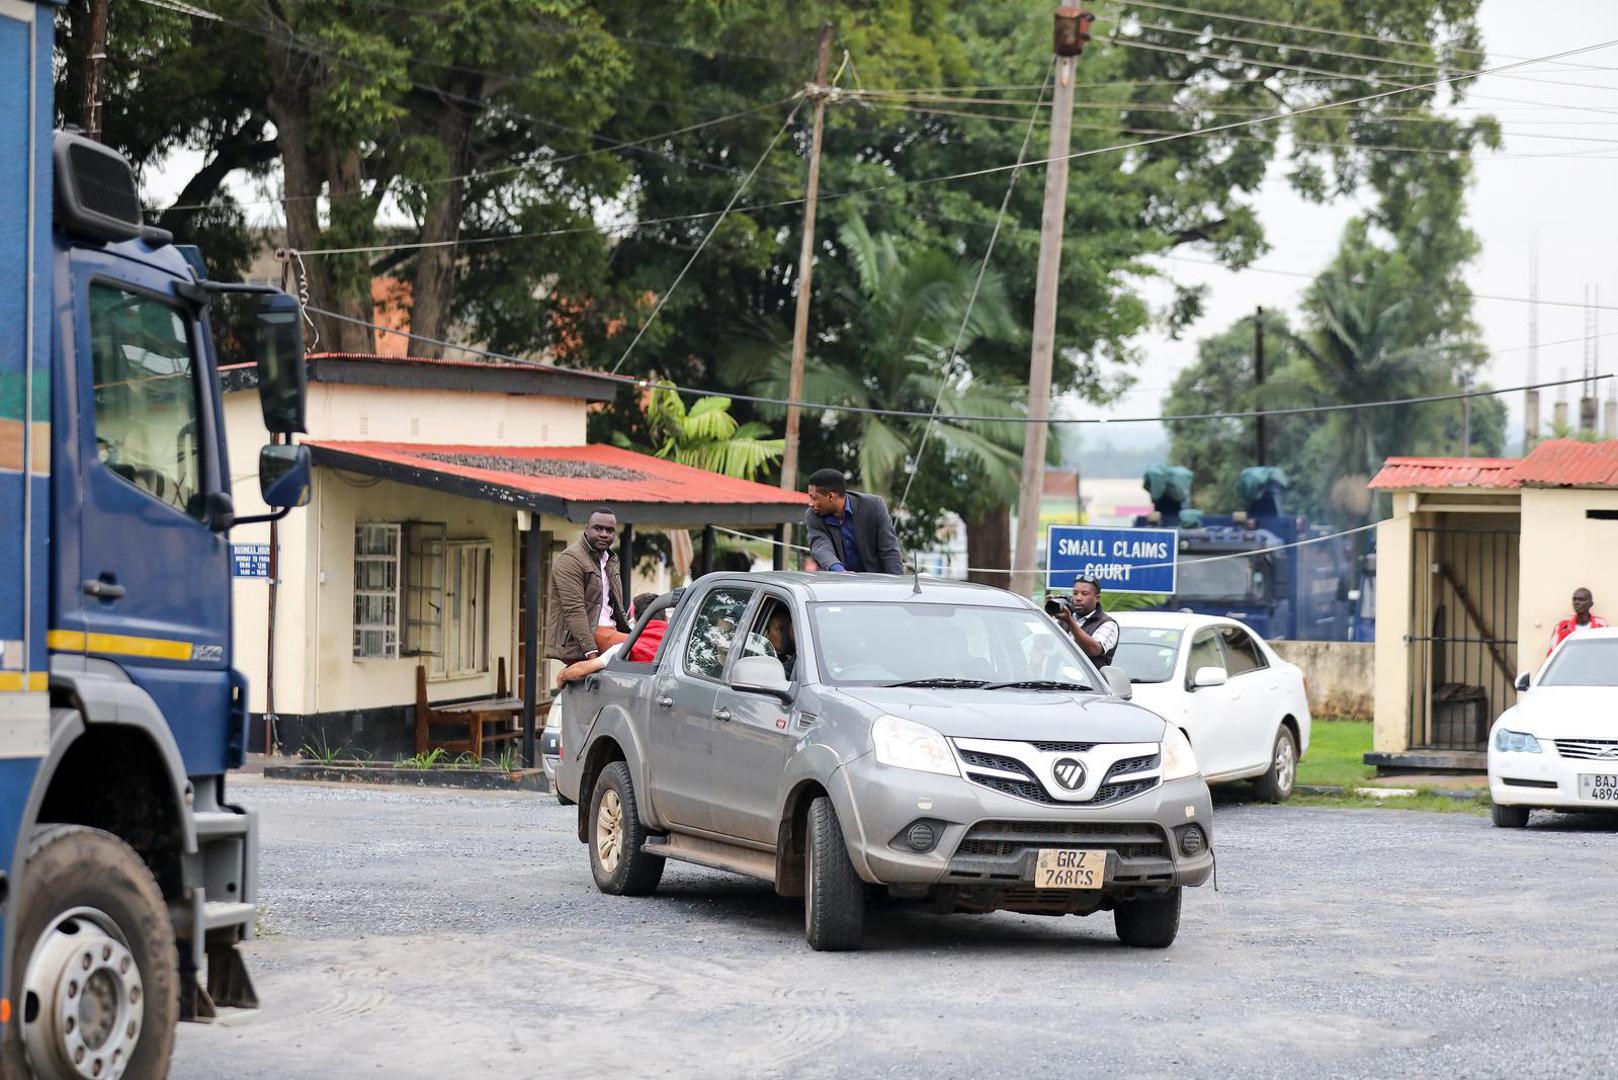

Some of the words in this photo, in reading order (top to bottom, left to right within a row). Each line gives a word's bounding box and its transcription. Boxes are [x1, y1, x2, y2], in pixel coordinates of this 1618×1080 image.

[1058, 538, 1107, 558] SMALL
[1113, 541, 1168, 559] CLAIMS
[1084, 563, 1133, 581] COURT
[1595, 775, 1617, 788] BAJ
[1592, 788, 1618, 801] 4896
[1057, 851, 1087, 868] GRZ
[1046, 870, 1094, 885] 768CS
